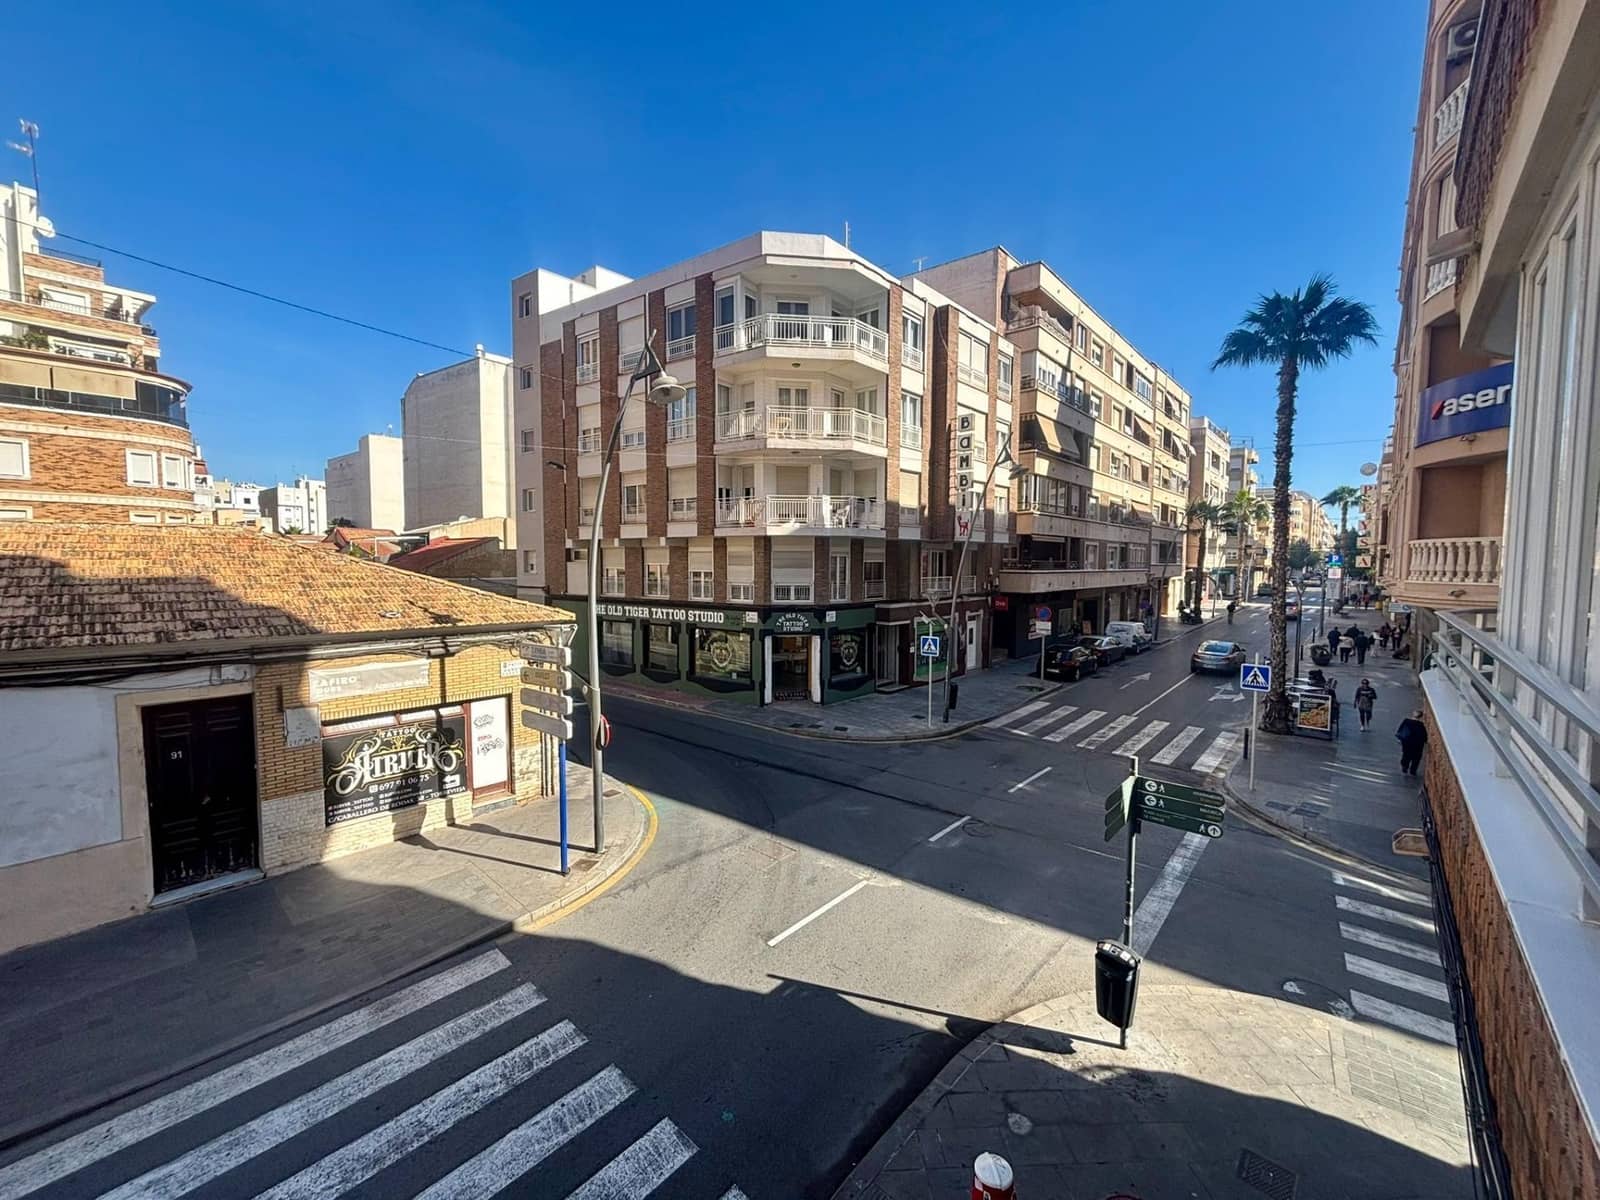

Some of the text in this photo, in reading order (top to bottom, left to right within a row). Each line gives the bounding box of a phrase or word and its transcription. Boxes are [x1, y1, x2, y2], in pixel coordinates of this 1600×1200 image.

[607, 605, 623, 617] OLD
[624, 606, 650, 618] TIGER
[651, 608, 686, 621] TATTOO
[688, 610, 724, 624] STUDIO
[381, 727, 416, 738] TATTOO
[170, 751, 183, 760] 91
[379, 782, 395, 791] 697
[419, 774, 430, 782] 75
